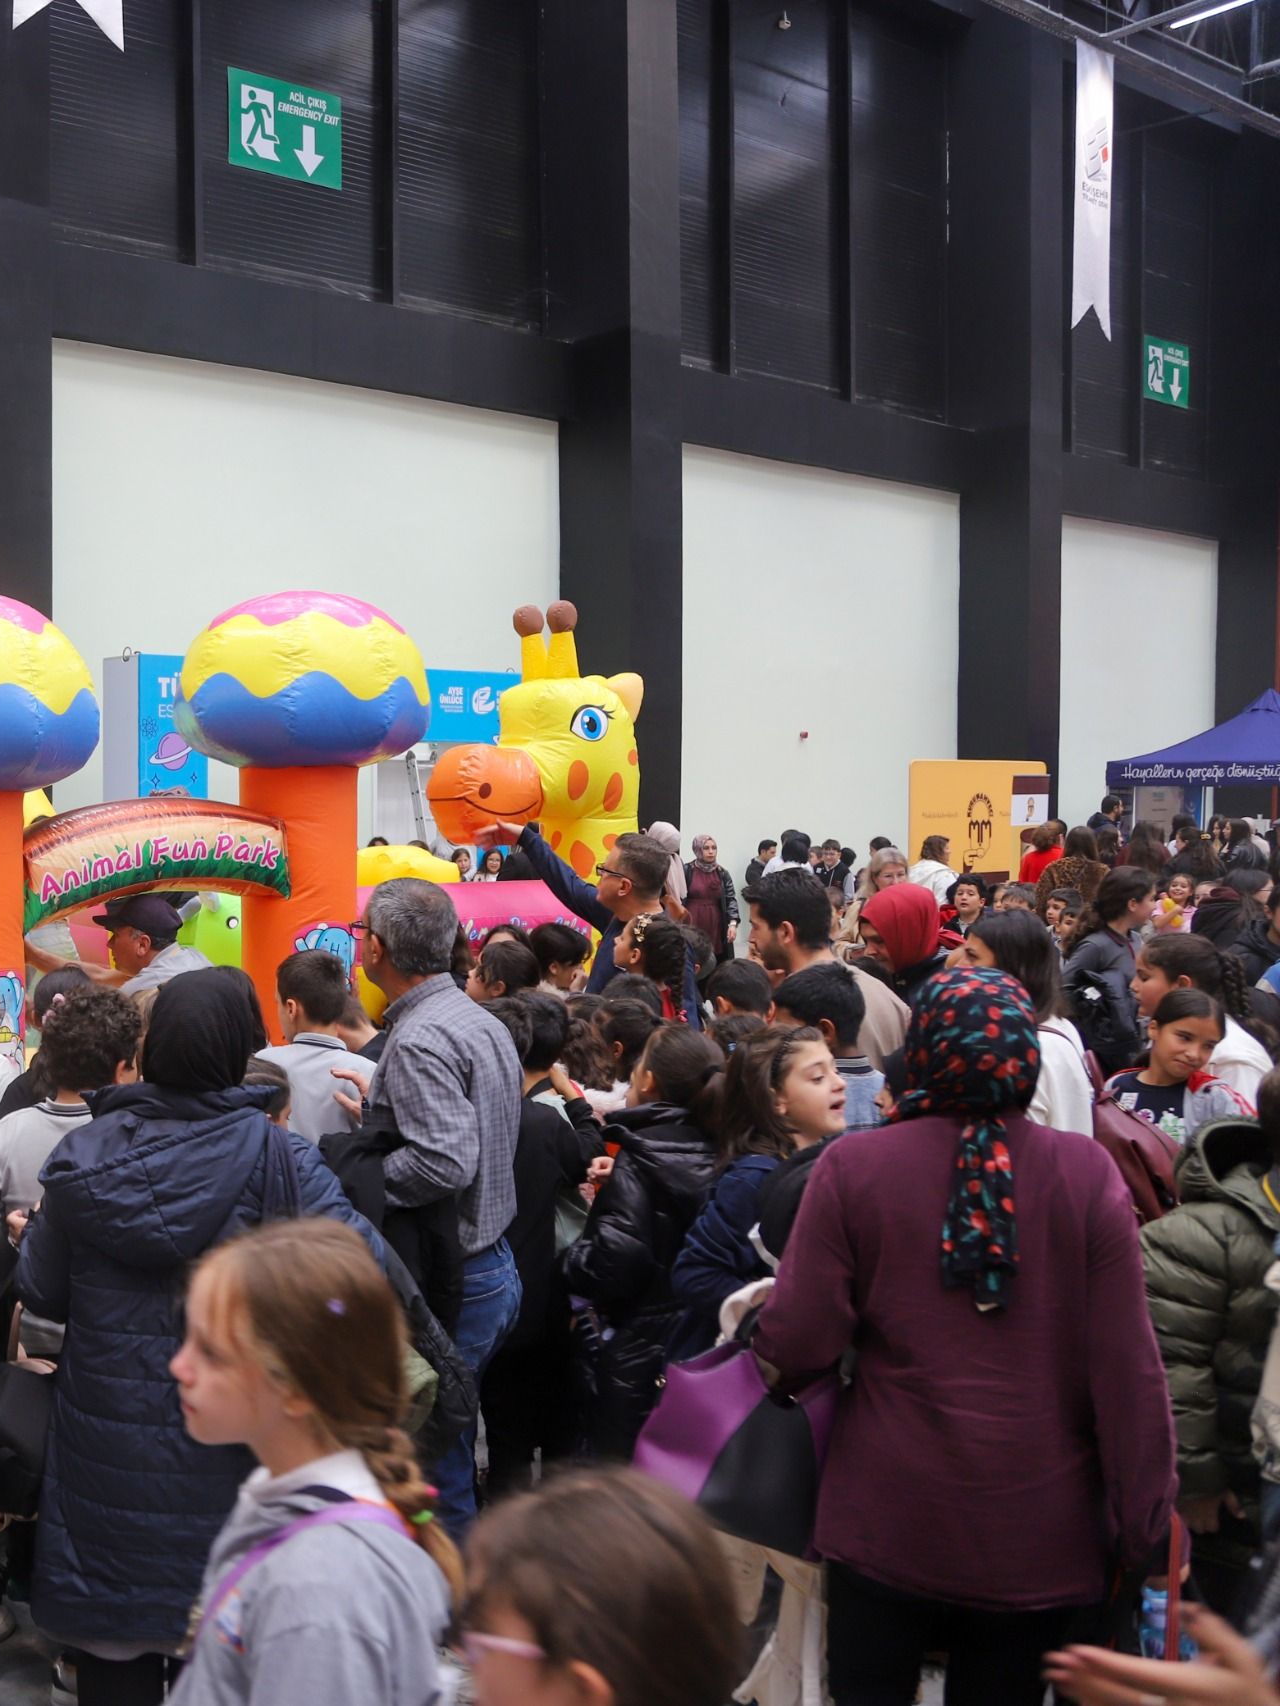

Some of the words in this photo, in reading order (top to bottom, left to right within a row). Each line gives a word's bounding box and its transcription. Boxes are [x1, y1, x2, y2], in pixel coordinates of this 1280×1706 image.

[277, 101, 323, 122] EMERGENCY
[323, 114, 340, 127] EXIT
[158, 704, 174, 718] ES
[1121, 763, 1184, 783] Hayallerin
[1185, 765, 1225, 783] gerçeğe
[40, 841, 142, 903] Animal
[150, 834, 207, 869] Fun
[214, 833, 280, 869] Park
